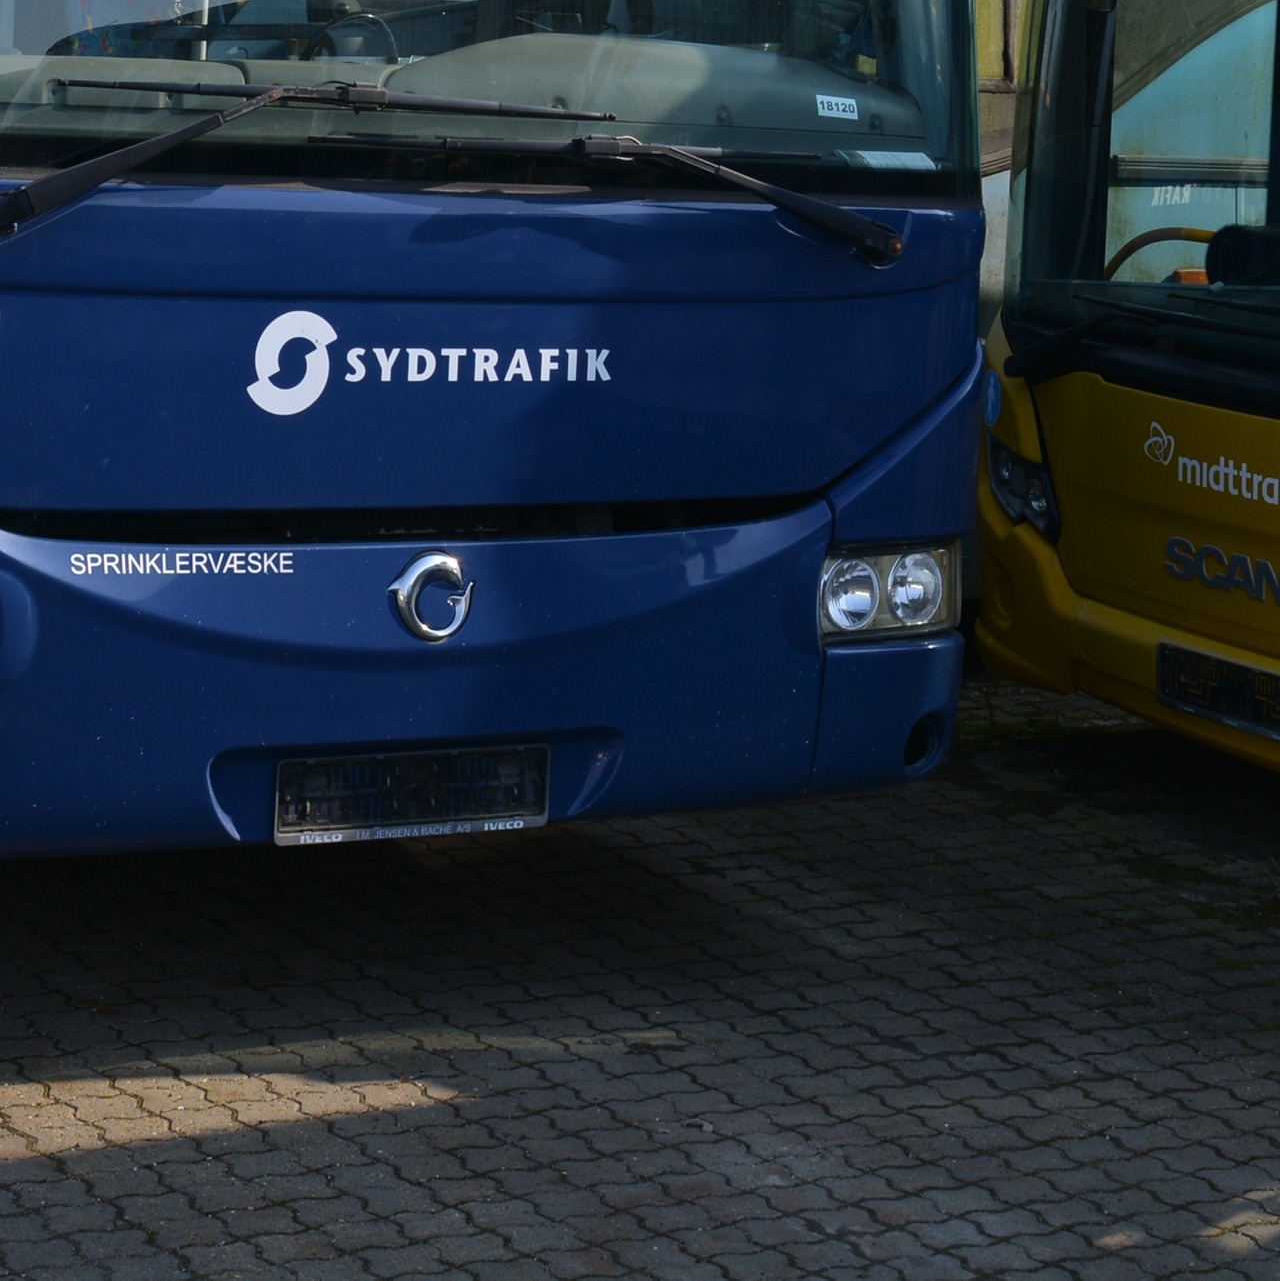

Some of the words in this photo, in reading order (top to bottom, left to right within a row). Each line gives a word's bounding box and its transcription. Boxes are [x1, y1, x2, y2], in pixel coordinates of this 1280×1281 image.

[819, 100, 855, 114] 18120
[344, 347, 612, 382] SYDTRAFIK
[70, 552, 294, 575] SPRINKLERVÆSKE
[300, 833, 342, 844] IVECO
[374, 828, 411, 839] JENSEN
[413, 827, 419, 837] &
[456, 823, 472, 833] A/S
[484, 820, 524, 831] IVECO
